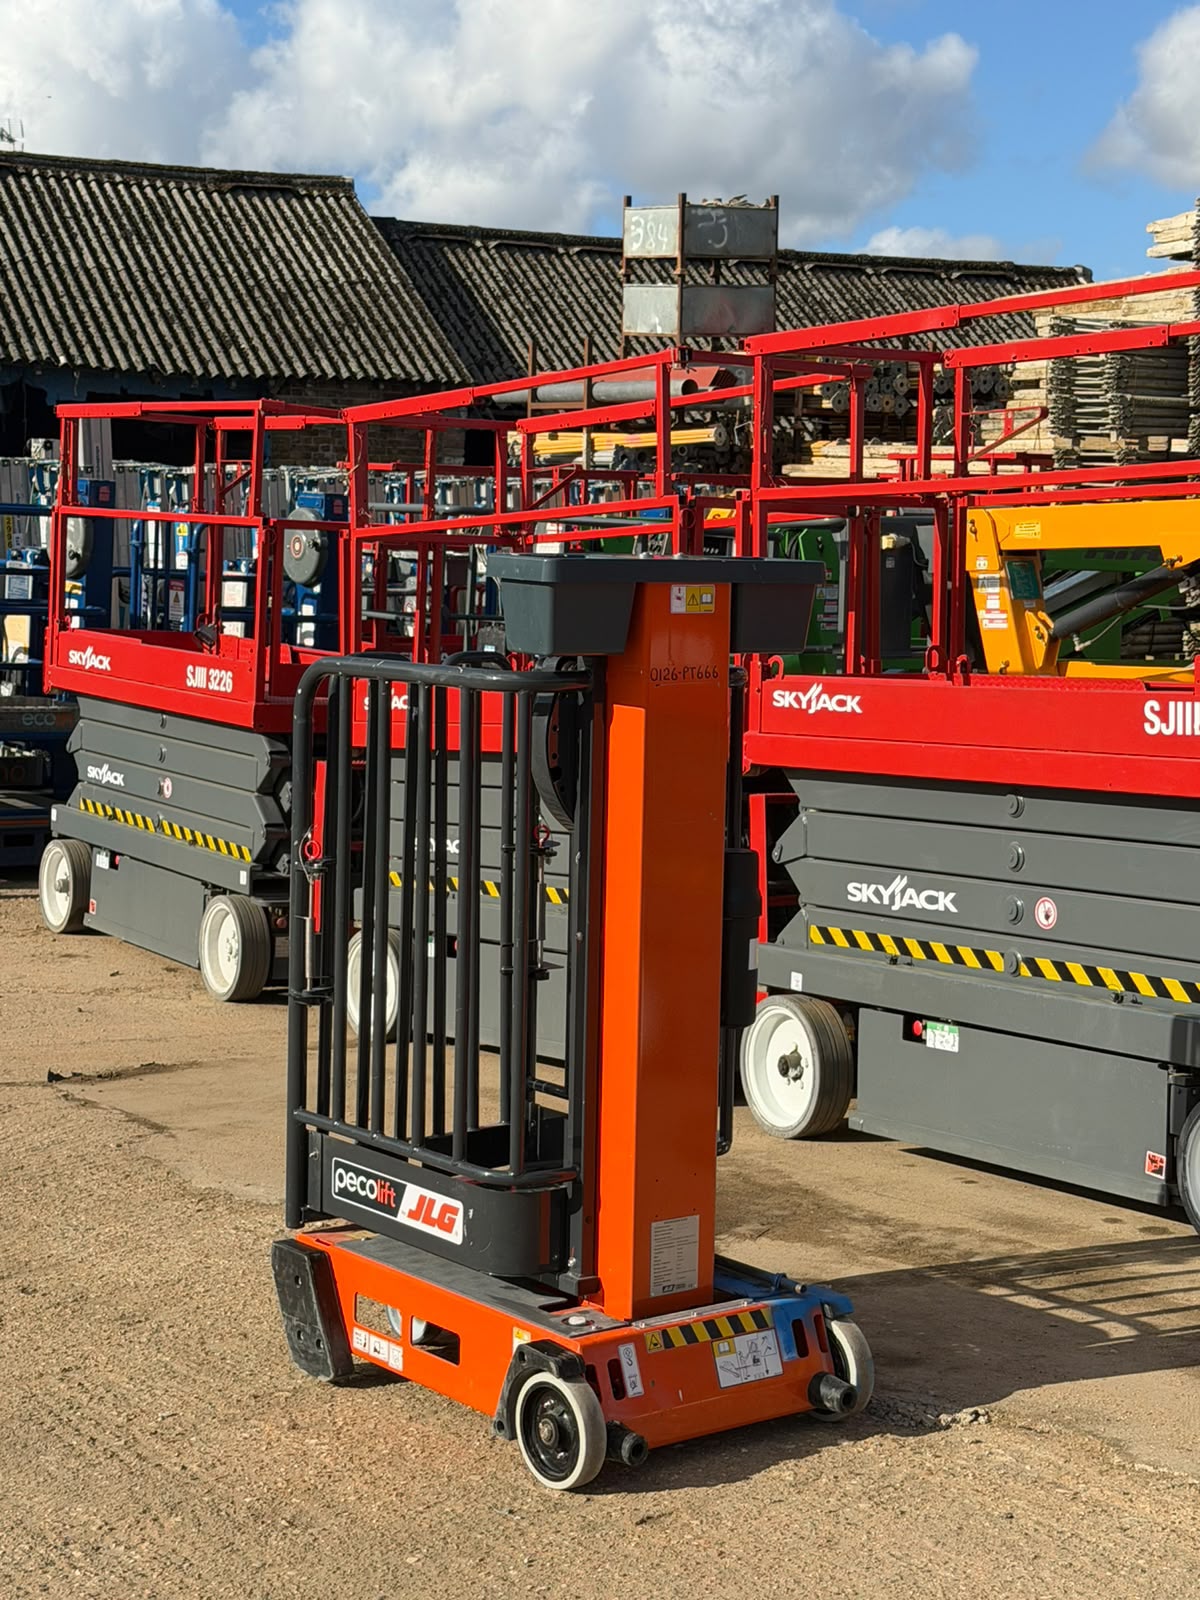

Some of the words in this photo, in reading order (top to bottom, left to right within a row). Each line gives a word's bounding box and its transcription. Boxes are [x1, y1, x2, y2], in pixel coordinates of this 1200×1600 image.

[68, 646, 111, 671] SKYJACK
[208, 667, 233, 693] 3226
[772, 683, 863, 714] SKYJACK
[87, 763, 126, 787] SKYJACK
[847, 874, 959, 914] SKYJACK
[334, 1167, 397, 1208] pecolift
[408, 1194, 458, 1233] JLG
